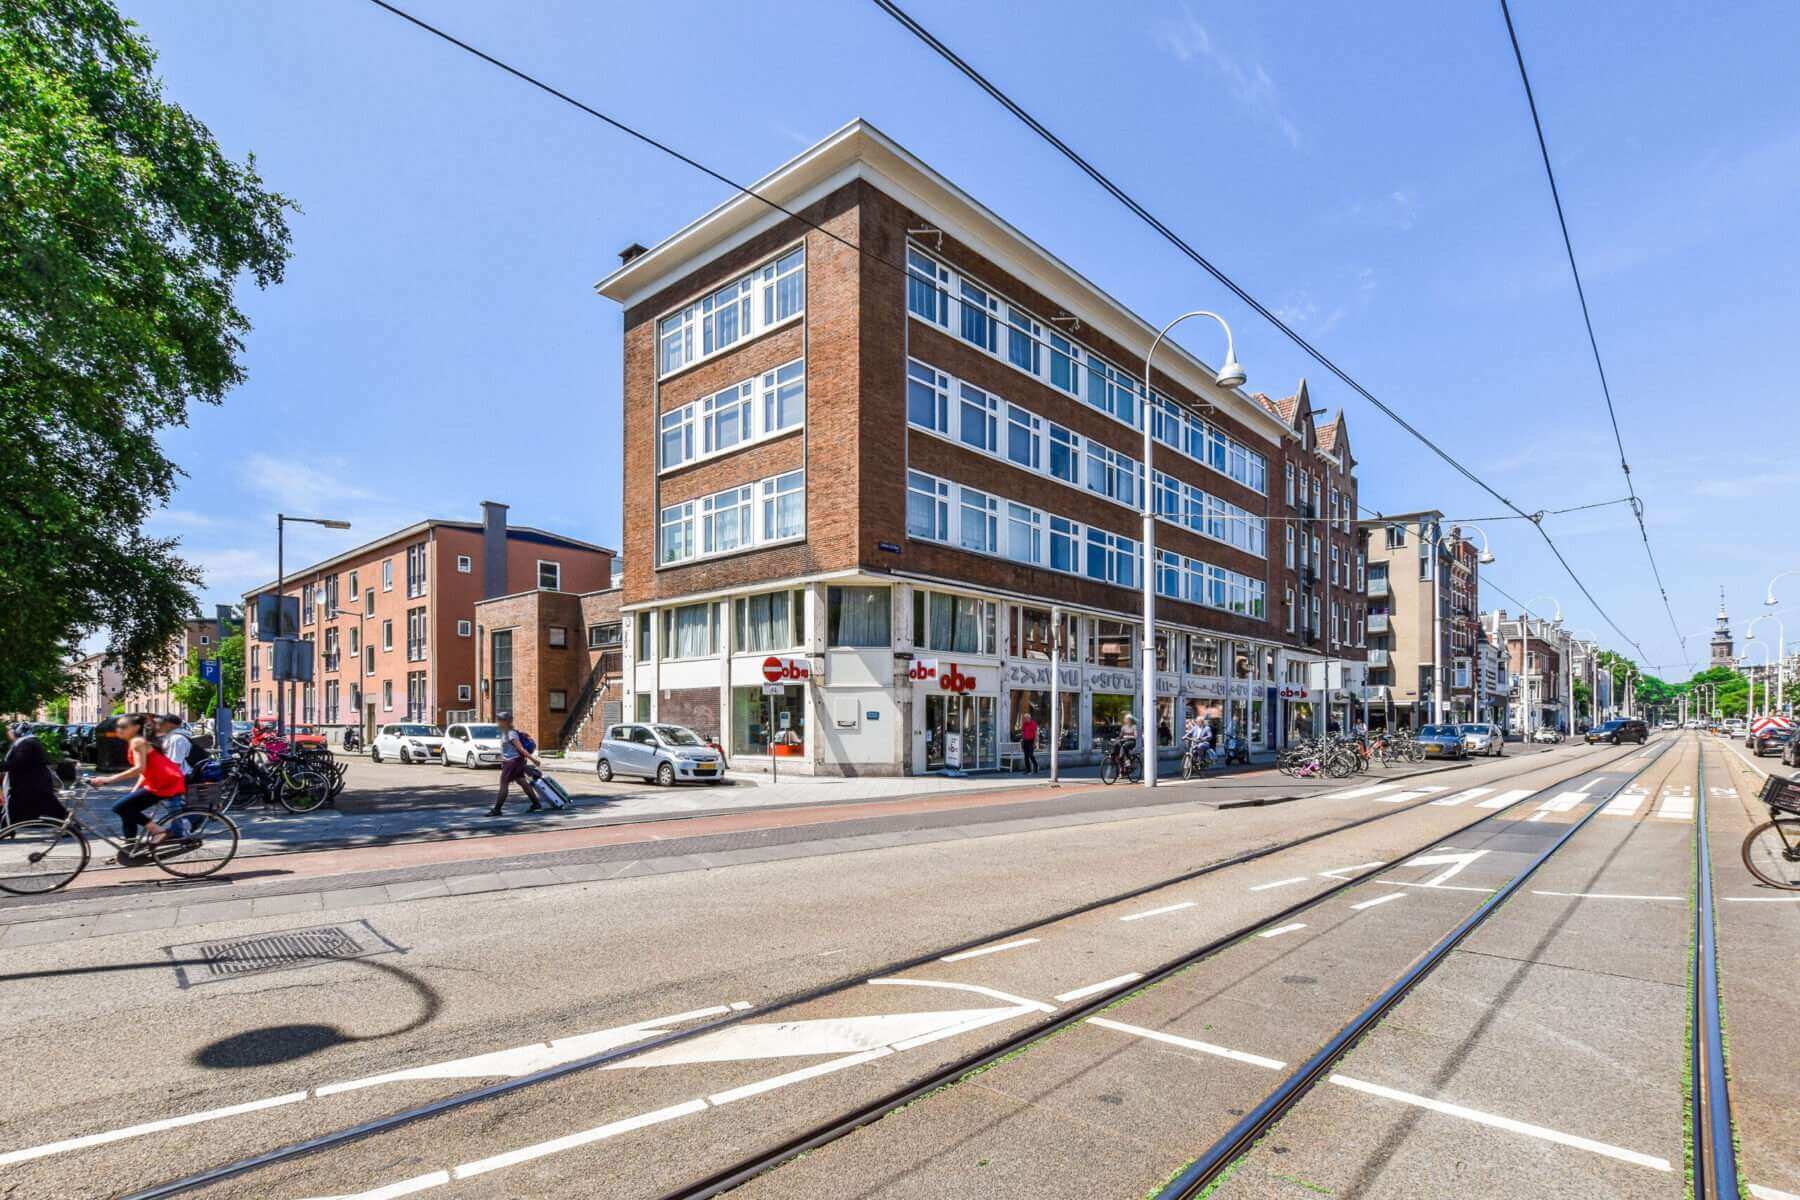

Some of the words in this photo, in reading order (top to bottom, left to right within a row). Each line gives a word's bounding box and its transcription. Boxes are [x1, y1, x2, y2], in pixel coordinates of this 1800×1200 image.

[781, 659, 809, 679] oba
[909, 660, 936, 679] oba
[940, 662, 977, 692] oba
